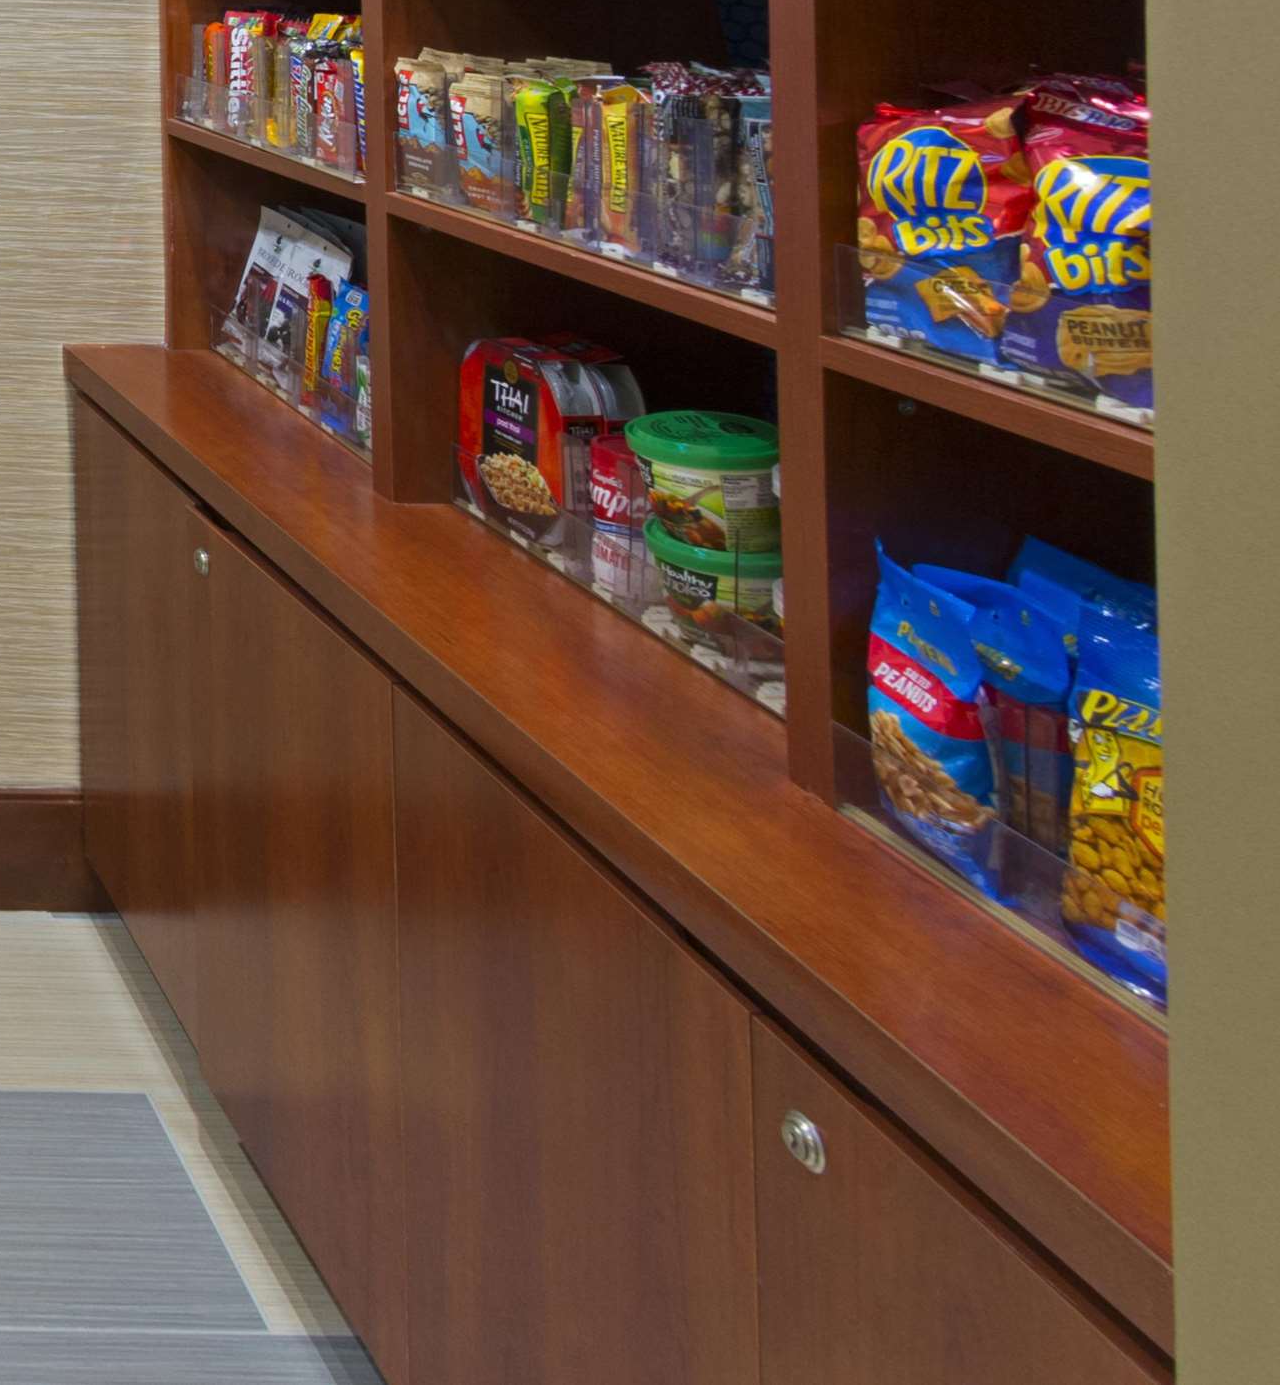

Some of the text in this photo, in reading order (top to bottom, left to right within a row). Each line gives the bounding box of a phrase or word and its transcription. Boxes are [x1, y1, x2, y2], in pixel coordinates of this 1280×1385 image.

[228, 27, 250, 127] Skittles
[608, 117, 623, 162] NATURE
[868, 142, 979, 213] RITZ
[896, 216, 990, 255] bits
[1049, 242, 1150, 290] bits
[1067, 318, 1148, 342] PEANUT
[490, 379, 530, 414] THAI
[873, 662, 937, 713] PEANUTS
